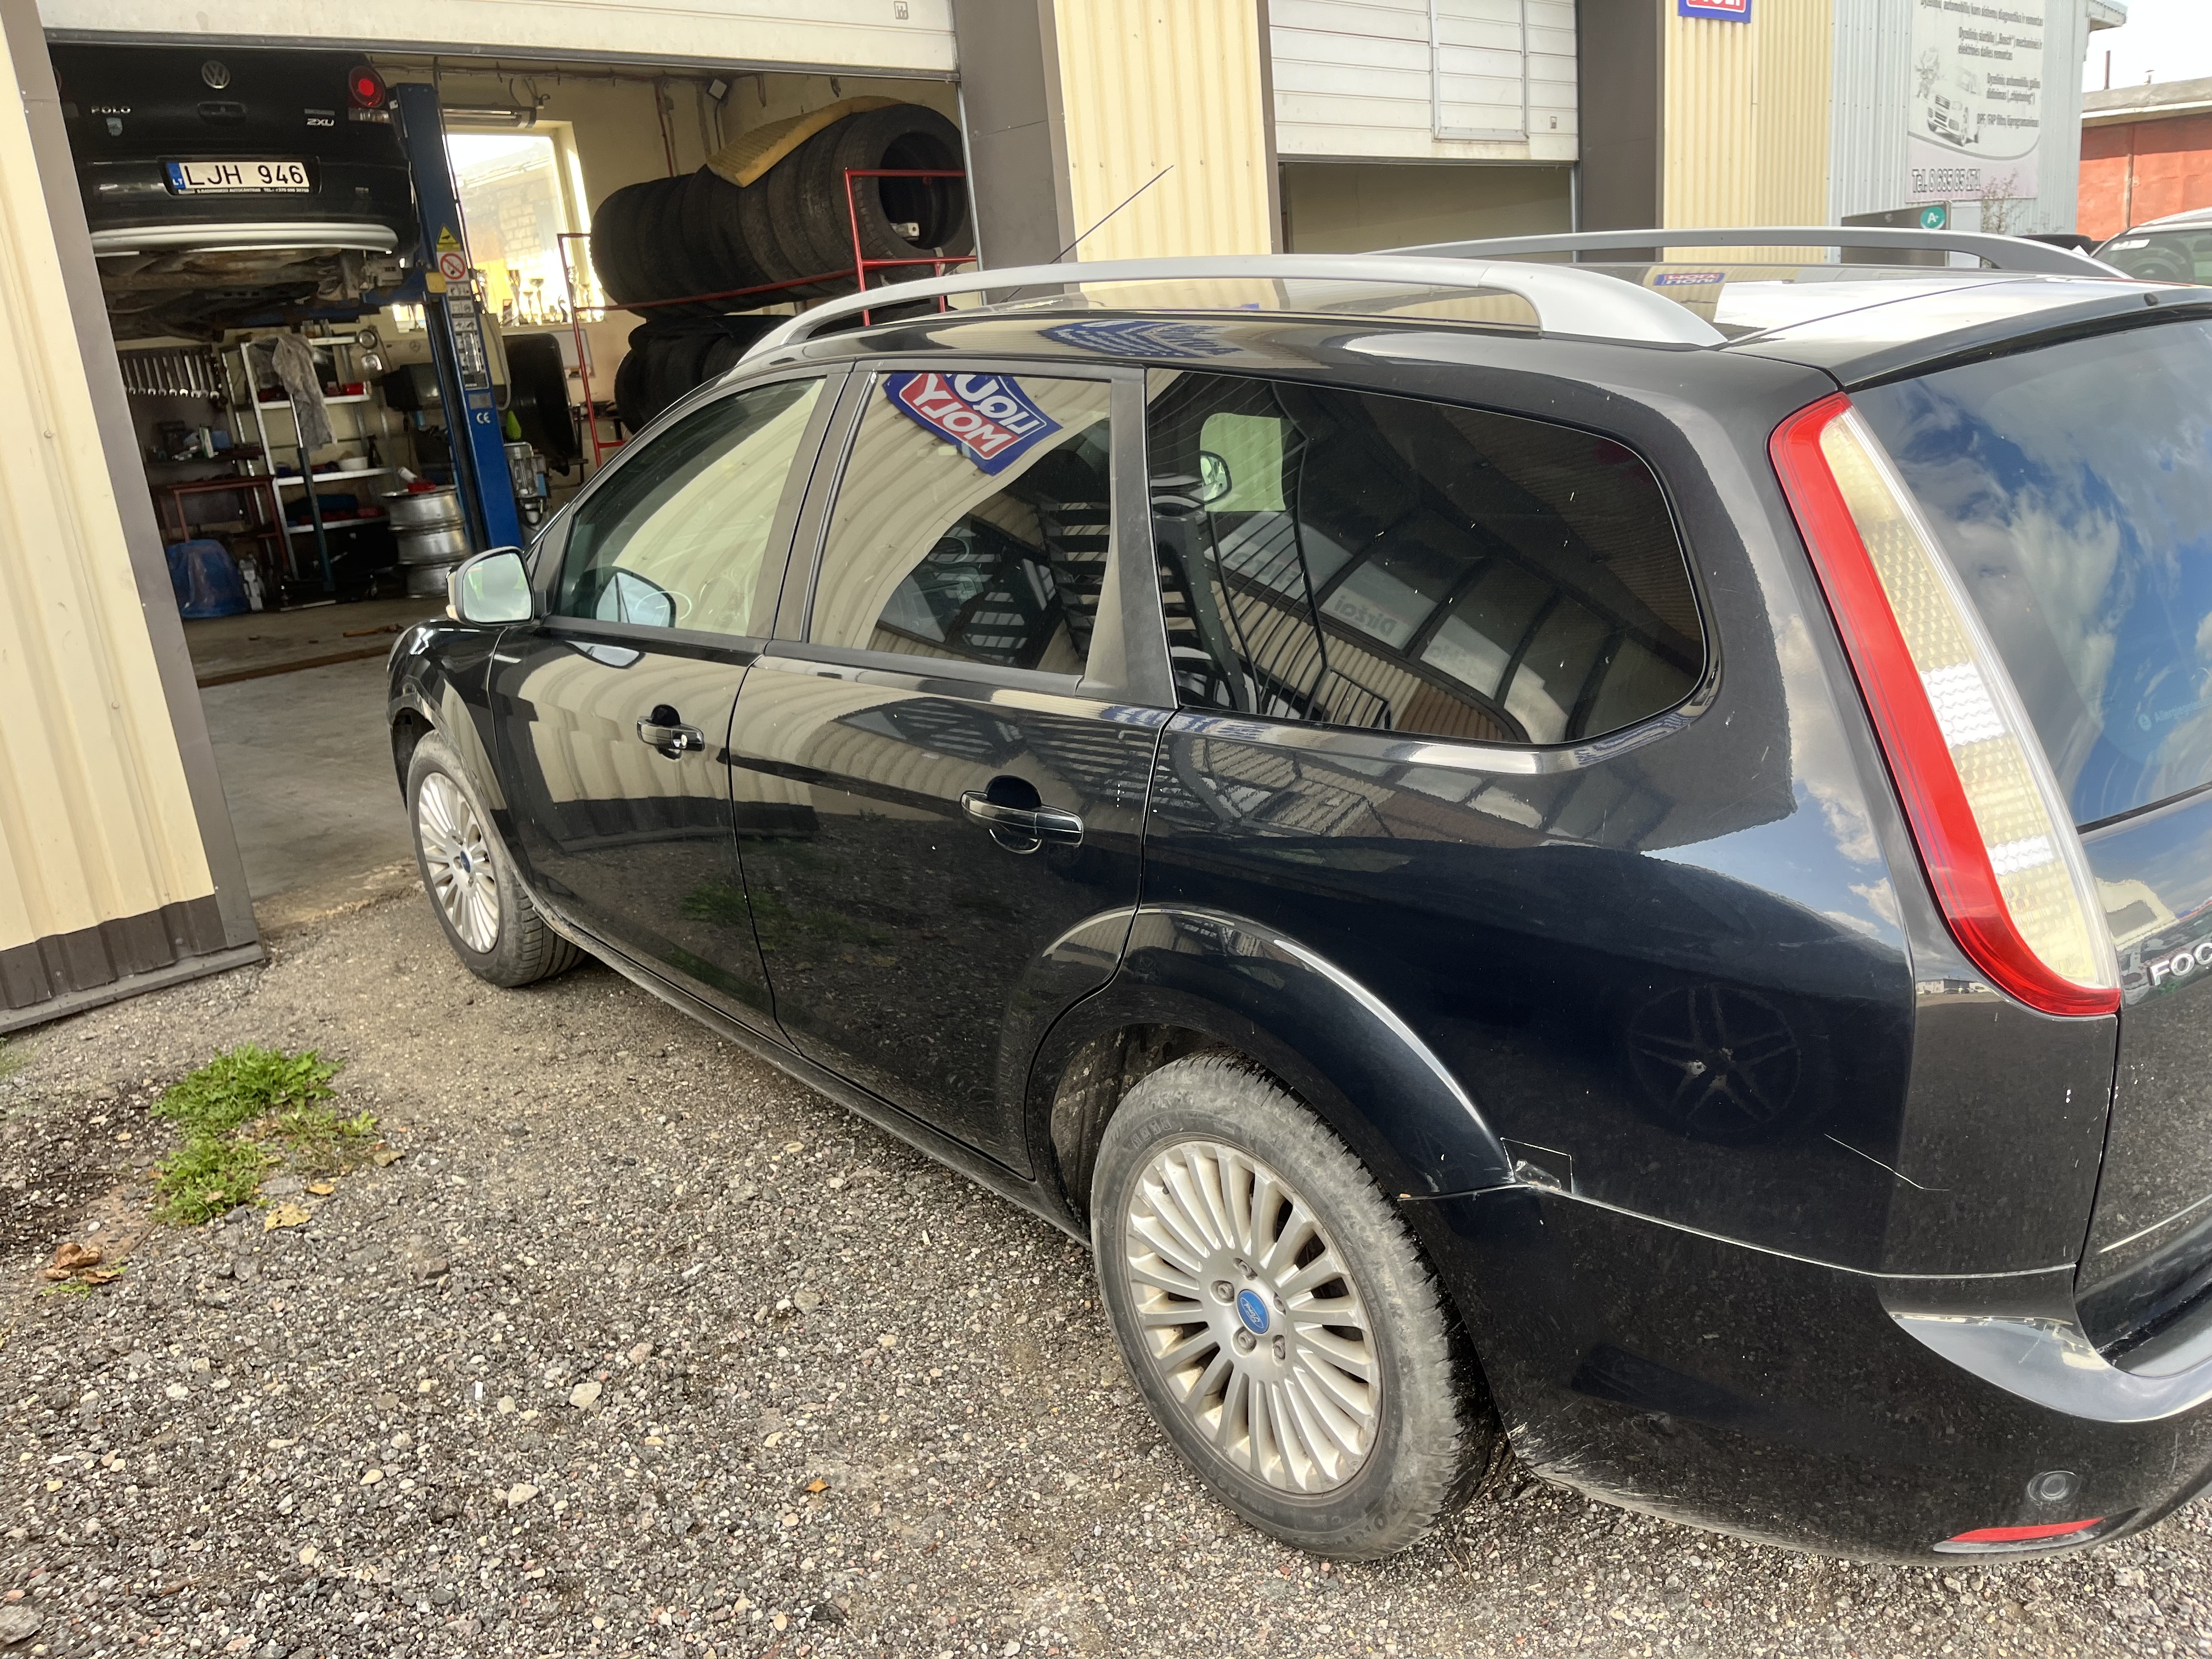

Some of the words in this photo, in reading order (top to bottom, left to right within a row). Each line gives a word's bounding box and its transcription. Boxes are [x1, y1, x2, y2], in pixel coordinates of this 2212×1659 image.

[91, 105, 132, 114] POLO
[184, 165, 242, 185] LJH
[258, 165, 303, 184] 946
